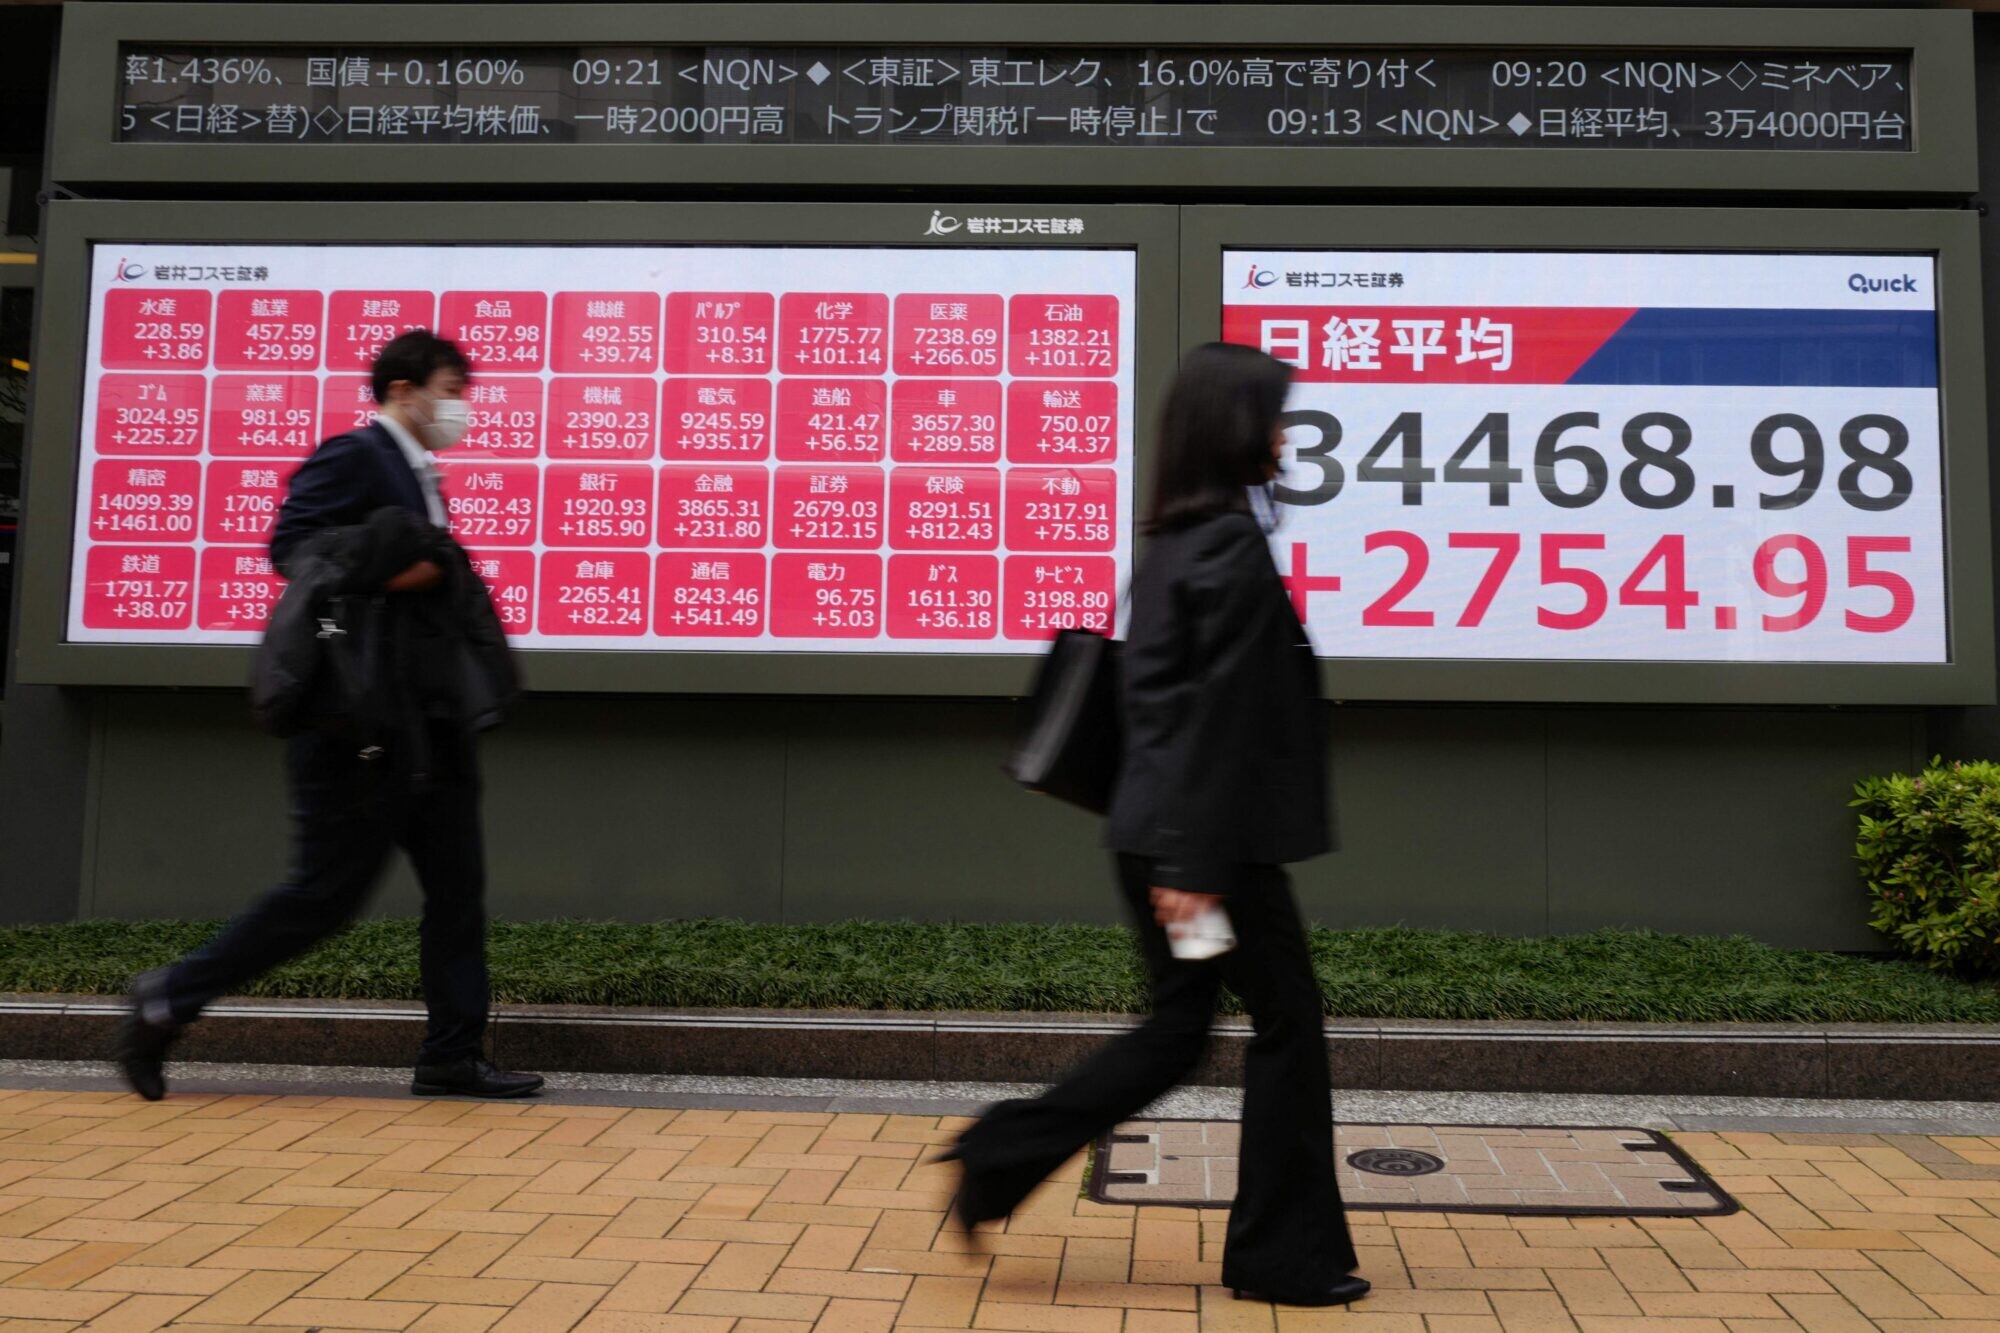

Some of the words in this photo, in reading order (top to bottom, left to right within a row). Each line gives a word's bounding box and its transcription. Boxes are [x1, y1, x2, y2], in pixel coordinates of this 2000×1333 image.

[573, 60, 661, 85] 09:21
[1492, 61, 1586, 87] 09:20
[1268, 109, 1361, 134] 09:13
[967, 218, 1084, 233] 岩井コスモ証券
[154, 266, 268, 281] 岩井コスモ証券
[1286, 272, 1404, 287] 岩井コスモ証券
[139, 298, 176, 315] 水産
[252, 299, 288, 316] 鉱業
[363, 300, 400, 317] 建設
[475, 300, 511, 317] 食品
[587, 301, 624, 318] 繊維
[815, 302, 853, 320] 化学
[931, 303, 967, 320] 医薬
[1045, 304, 1082, 321] 石油
[135, 323, 204, 339] 228.59
[246, 324, 316, 340] 457.59
[459, 325, 539, 342] 1657.98
[583, 326, 652, 342] 492.55
[697, 327, 767, 343] 310.54
[800, 327, 882, 344] 1775.77
[914, 328, 997, 345] 7238.69
[1030, 329, 1111, 346] 1382.21
[143, 343, 202, 359] +3.86
[243, 344, 314, 360] +29.99
[1261, 314, 1514, 373] 日経平均
[467, 345, 538, 361] +23.44
[580, 346, 652, 362] +39.74
[706, 347, 764, 363] +8.31
[796, 348, 881, 364] +101.14
[910, 348, 996, 365] +266.05
[1025, 349, 1111, 366] +101.72
[471, 386, 507, 403] 非鉄
[584, 387, 622, 405] 機械
[698, 388, 736, 405] 電気
[813, 388, 851, 406] 造船
[938, 389, 956, 407] 車
[1043, 390, 1080, 408] 輸送
[117, 408, 198, 425] 3024.95
[242, 409, 310, 426] 981.95
[567, 412, 649, 428] 2390.23
[681, 413, 764, 429] 9245.59
[808, 414, 879, 430] 421.47
[912, 415, 995, 431] 3657.30
[1040, 416, 1110, 432] 750.07
[112, 428, 198, 445] +225.27
[238, 430, 307, 446] +64.41
[460, 431, 534, 448] +43.32
[563, 432, 649, 449] +159.07
[678, 433, 764, 450] +935.17
[805, 434, 878, 451] +56.52
[908, 435, 994, 452] +289.58
[1037, 436, 1110, 453] +34.37
[1274, 411, 1914, 511] 34468.98
[128, 469, 166, 486] 精密
[241, 470, 278, 488] 製造
[465, 472, 503, 490] 小売
[580, 473, 617, 491] 銀行
[695, 474, 732, 492] 金融
[810, 475, 848, 493] 証券
[925, 474, 965, 493] 保険
[1042, 477, 1080, 495] 不動
[99, 494, 193, 511] 14099.39
[225, 495, 287, 512] 1706.
[449, 498, 531, 514] 8602.43
[564, 499, 646, 516] 1920.93
[678, 500, 760, 517] 3865.31
[794, 501, 877, 518] 2679.03
[909, 502, 992, 519] 8291.51
[1026, 503, 1108, 520] 2317.91
[94, 514, 192, 531] +1461.00
[560, 519, 645, 536] +185.90
[674, 520, 761, 537] +231.80
[790, 521, 876, 538] +212.15
[906, 522, 992, 539] +812.43
[1035, 524, 1109, 540] +75.58
[122, 555, 160, 573] 鉄道
[235, 556, 272, 575] 陸運
[576, 561, 614, 579] 倉庫
[691, 562, 729, 579] 通信
[808, 563, 845, 581] 電力
[106, 581, 188, 597] 1791.77
[220, 582, 287, 599] 1339.7
[1281, 531, 1916, 633] +2754.95
[559, 586, 640, 604] 2265.41
[674, 588, 758, 605] 8243.46
[816, 589, 875, 606] 96.75
[909, 590, 991, 607] 1611.30
[1024, 591, 1108, 608] 3198.80
[113, 601, 186, 618] +38.07
[568, 607, 641, 624] +82.24
[671, 608, 758, 625] +541.49
[813, 610, 874, 627] +5.03
[917, 611, 991, 628] +36.18
[1020, 612, 1107, 629] +140.82
